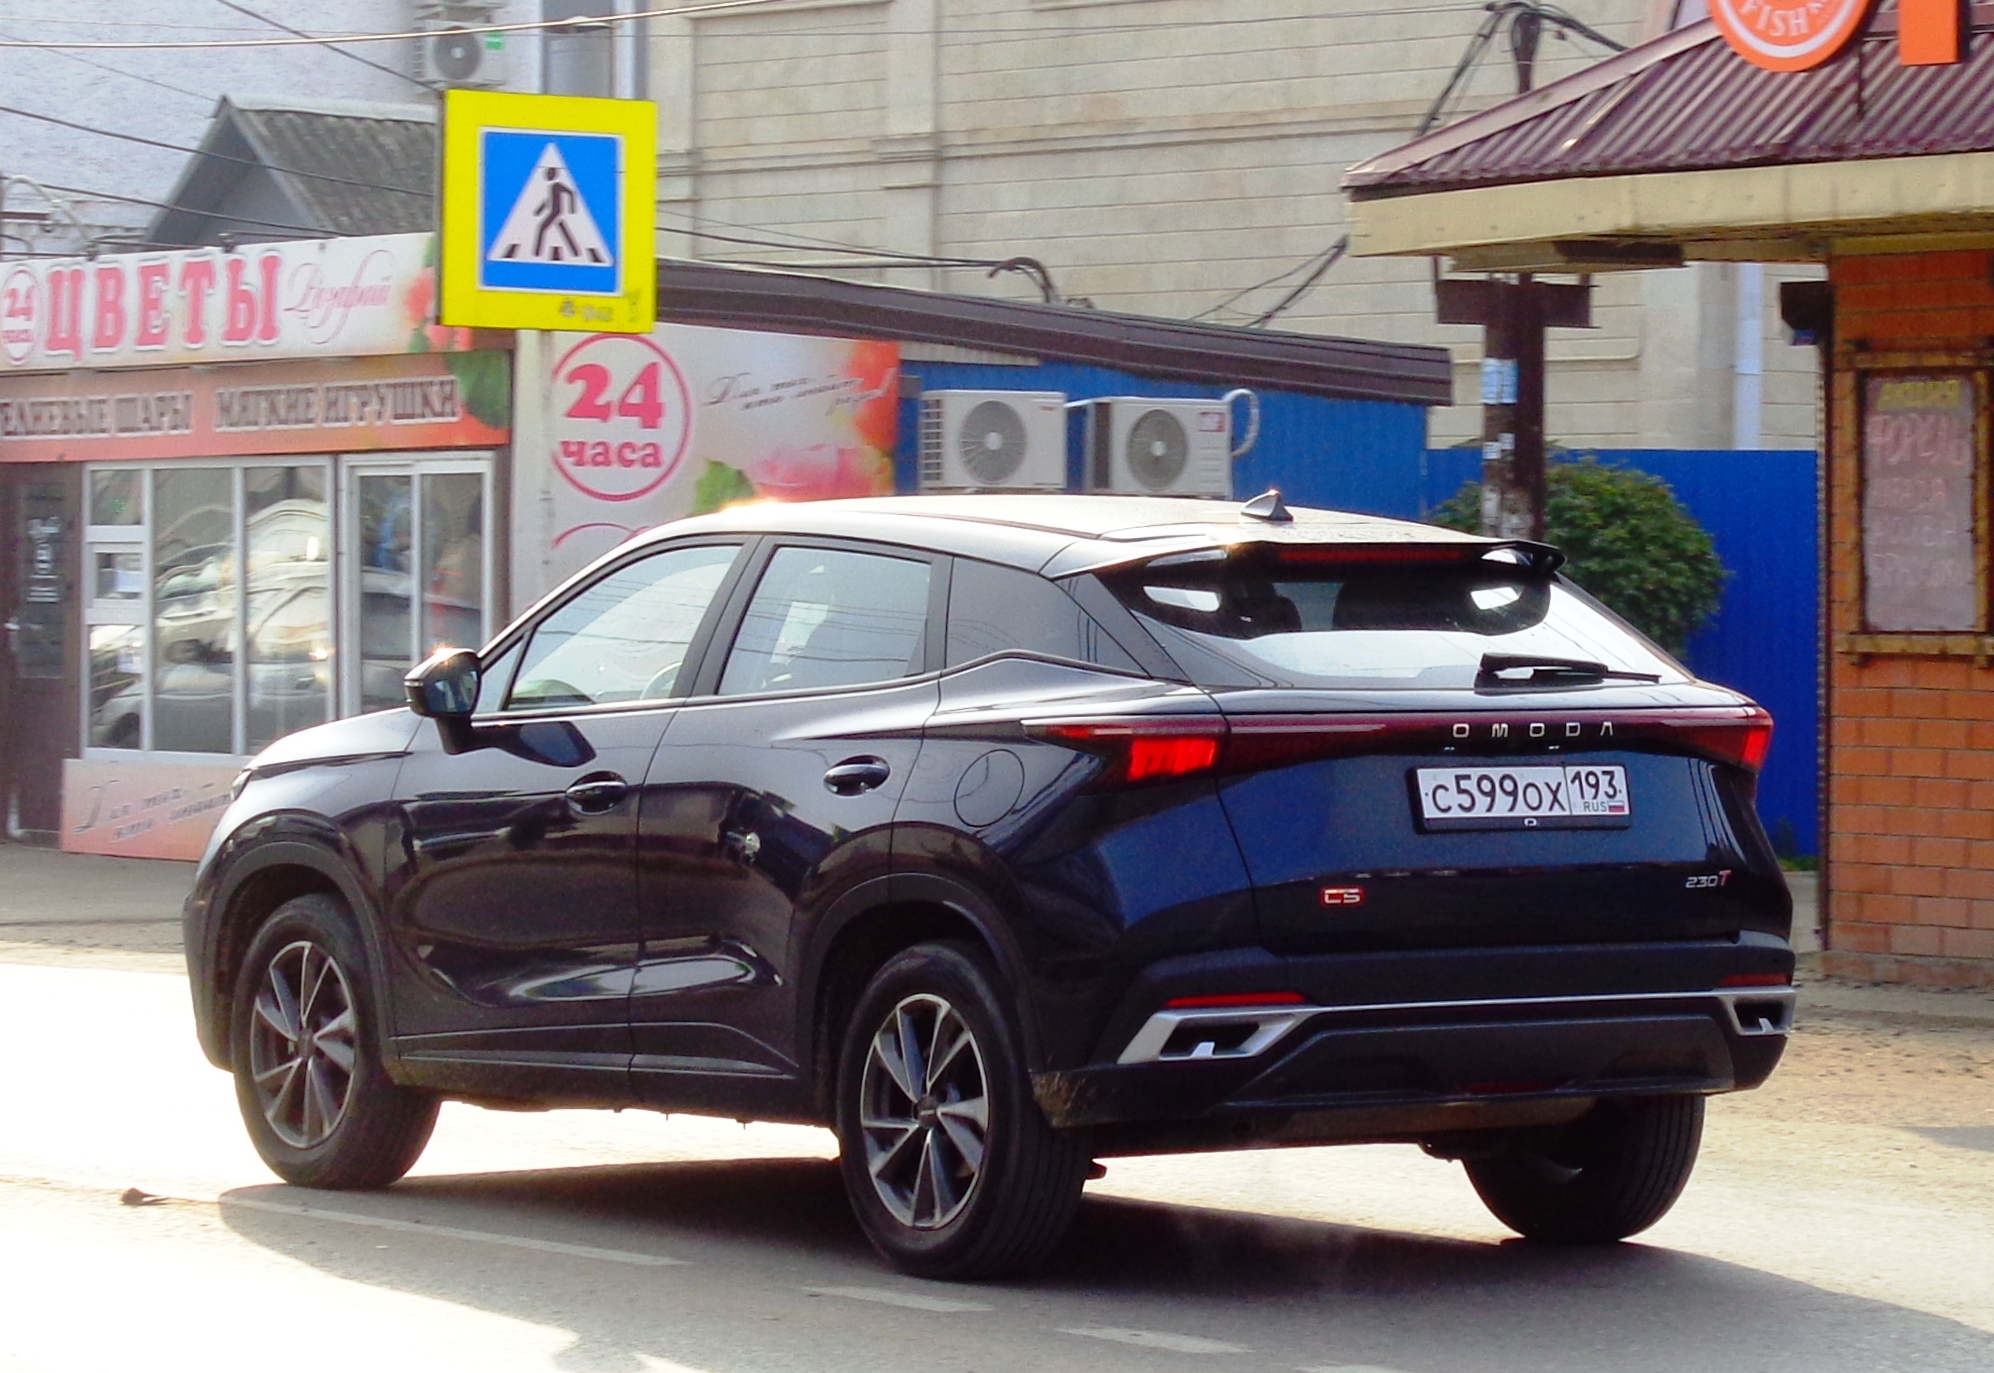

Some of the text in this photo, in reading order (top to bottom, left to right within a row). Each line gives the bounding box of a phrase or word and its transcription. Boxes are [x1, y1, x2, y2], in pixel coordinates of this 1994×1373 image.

[44, 253, 283, 361] ЦВЕТЫ
[215, 375, 461, 432] МЯГКИЕ ИГРУШКИ
[565, 362, 666, 429] 24
[560, 440, 665, 468] часа
[1570, 770, 1618, 800] 193
[1583, 801, 1608, 813] RUS
[1685, 869, 1732, 889] 230T
